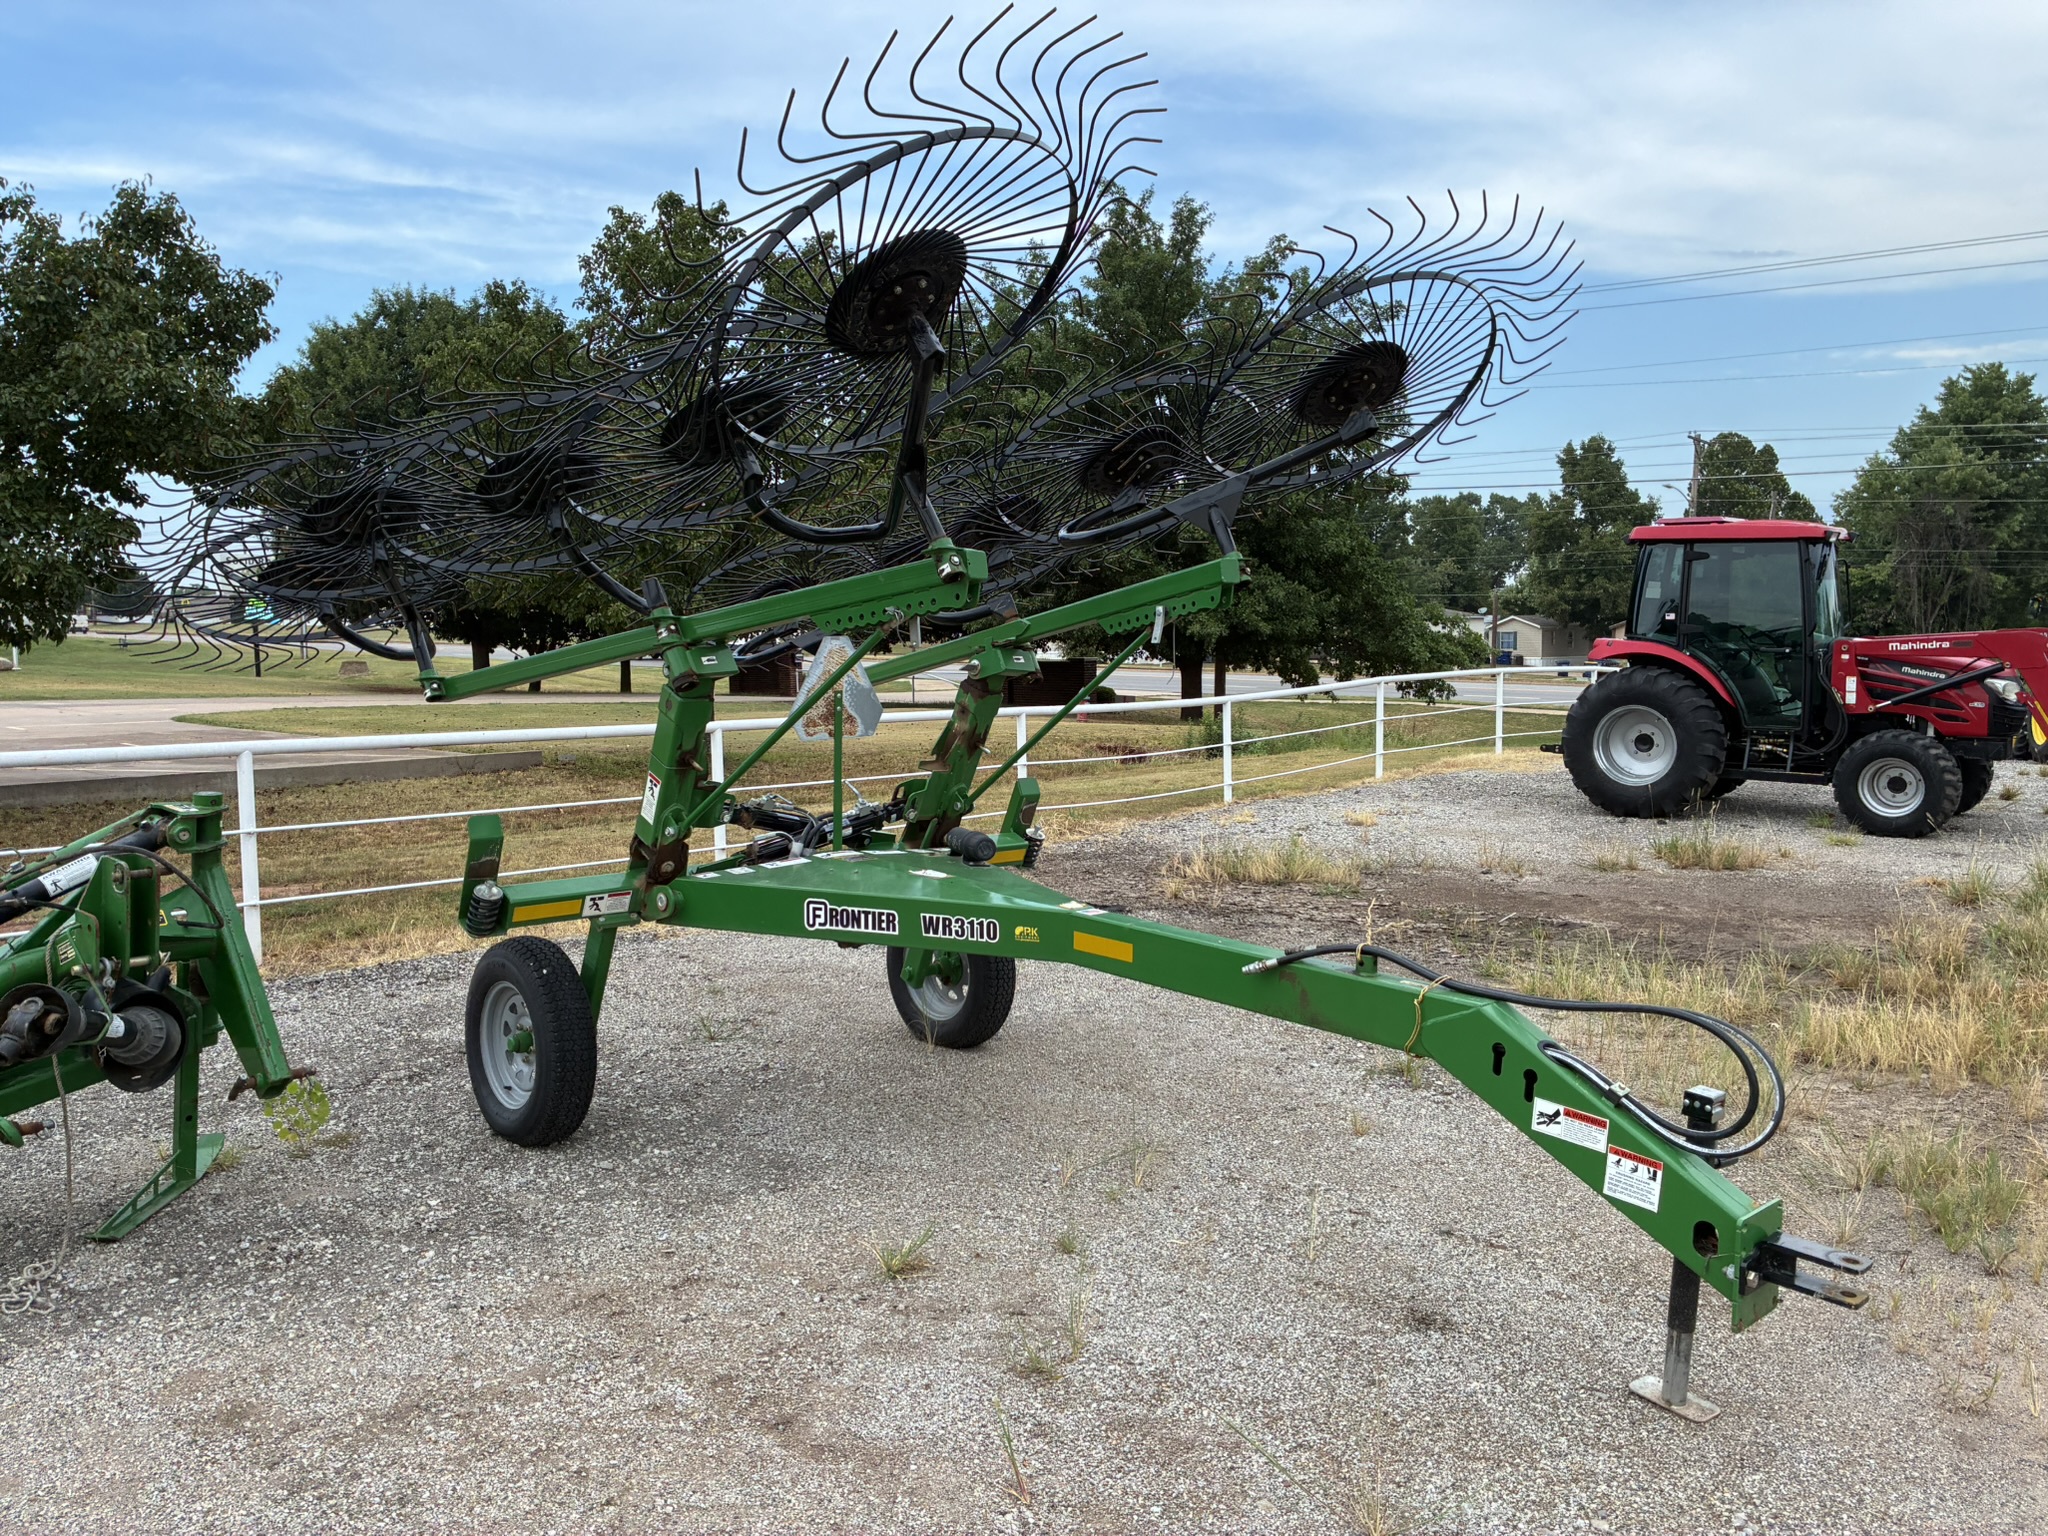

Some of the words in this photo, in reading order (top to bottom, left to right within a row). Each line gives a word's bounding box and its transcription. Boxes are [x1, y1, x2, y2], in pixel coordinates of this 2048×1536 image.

[1889, 640, 1950, 651] Mahindra
[1901, 666, 1946, 680] Mahindra
[805, 899, 898, 934] FRONTIER
[921, 914, 998, 942] WR3110
[1570, 1111, 1606, 1128] WARNING
[1621, 1151, 1657, 1168] WARNING
